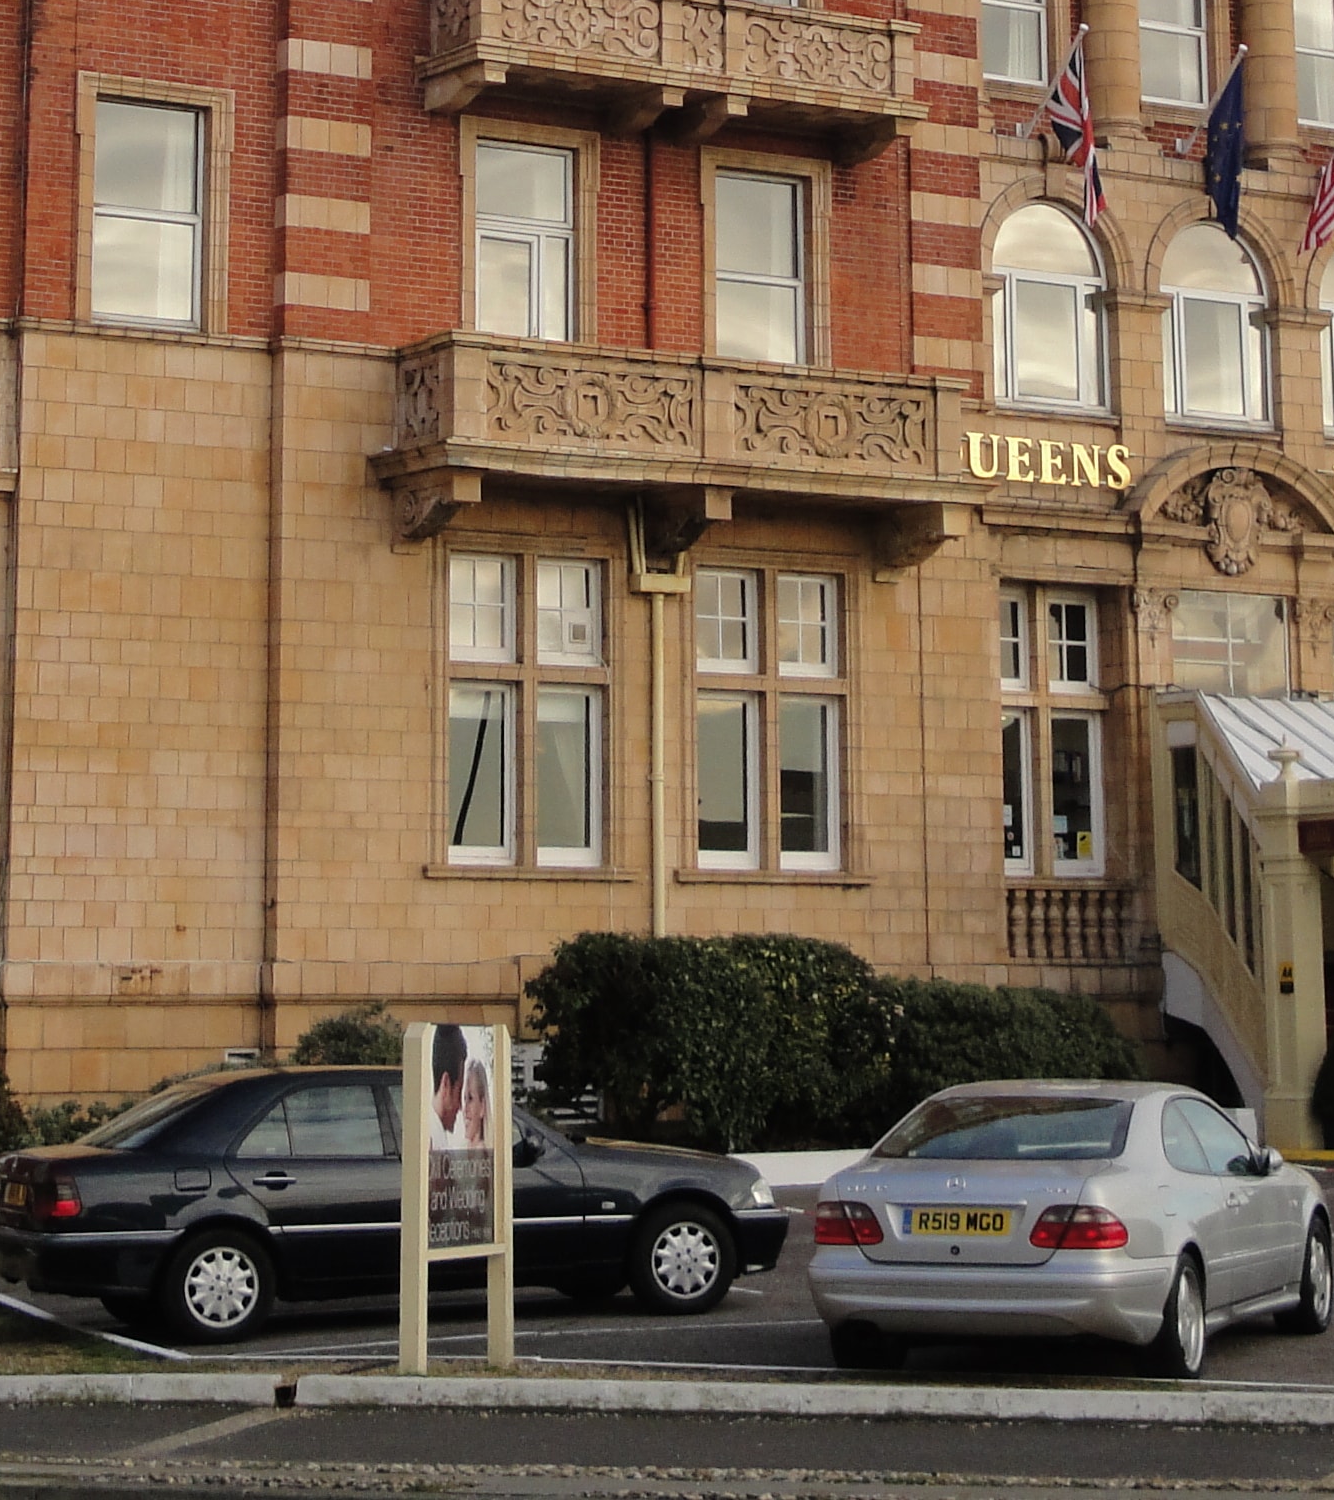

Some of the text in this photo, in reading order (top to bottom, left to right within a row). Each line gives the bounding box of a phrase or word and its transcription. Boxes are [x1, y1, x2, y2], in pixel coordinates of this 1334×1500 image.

[960, 431, 1132, 490] UEENS
[430, 1186, 485, 1213] and Wedding
[428, 1220, 470, 1242] eceptions
[918, 1212, 960, 1230] R519
